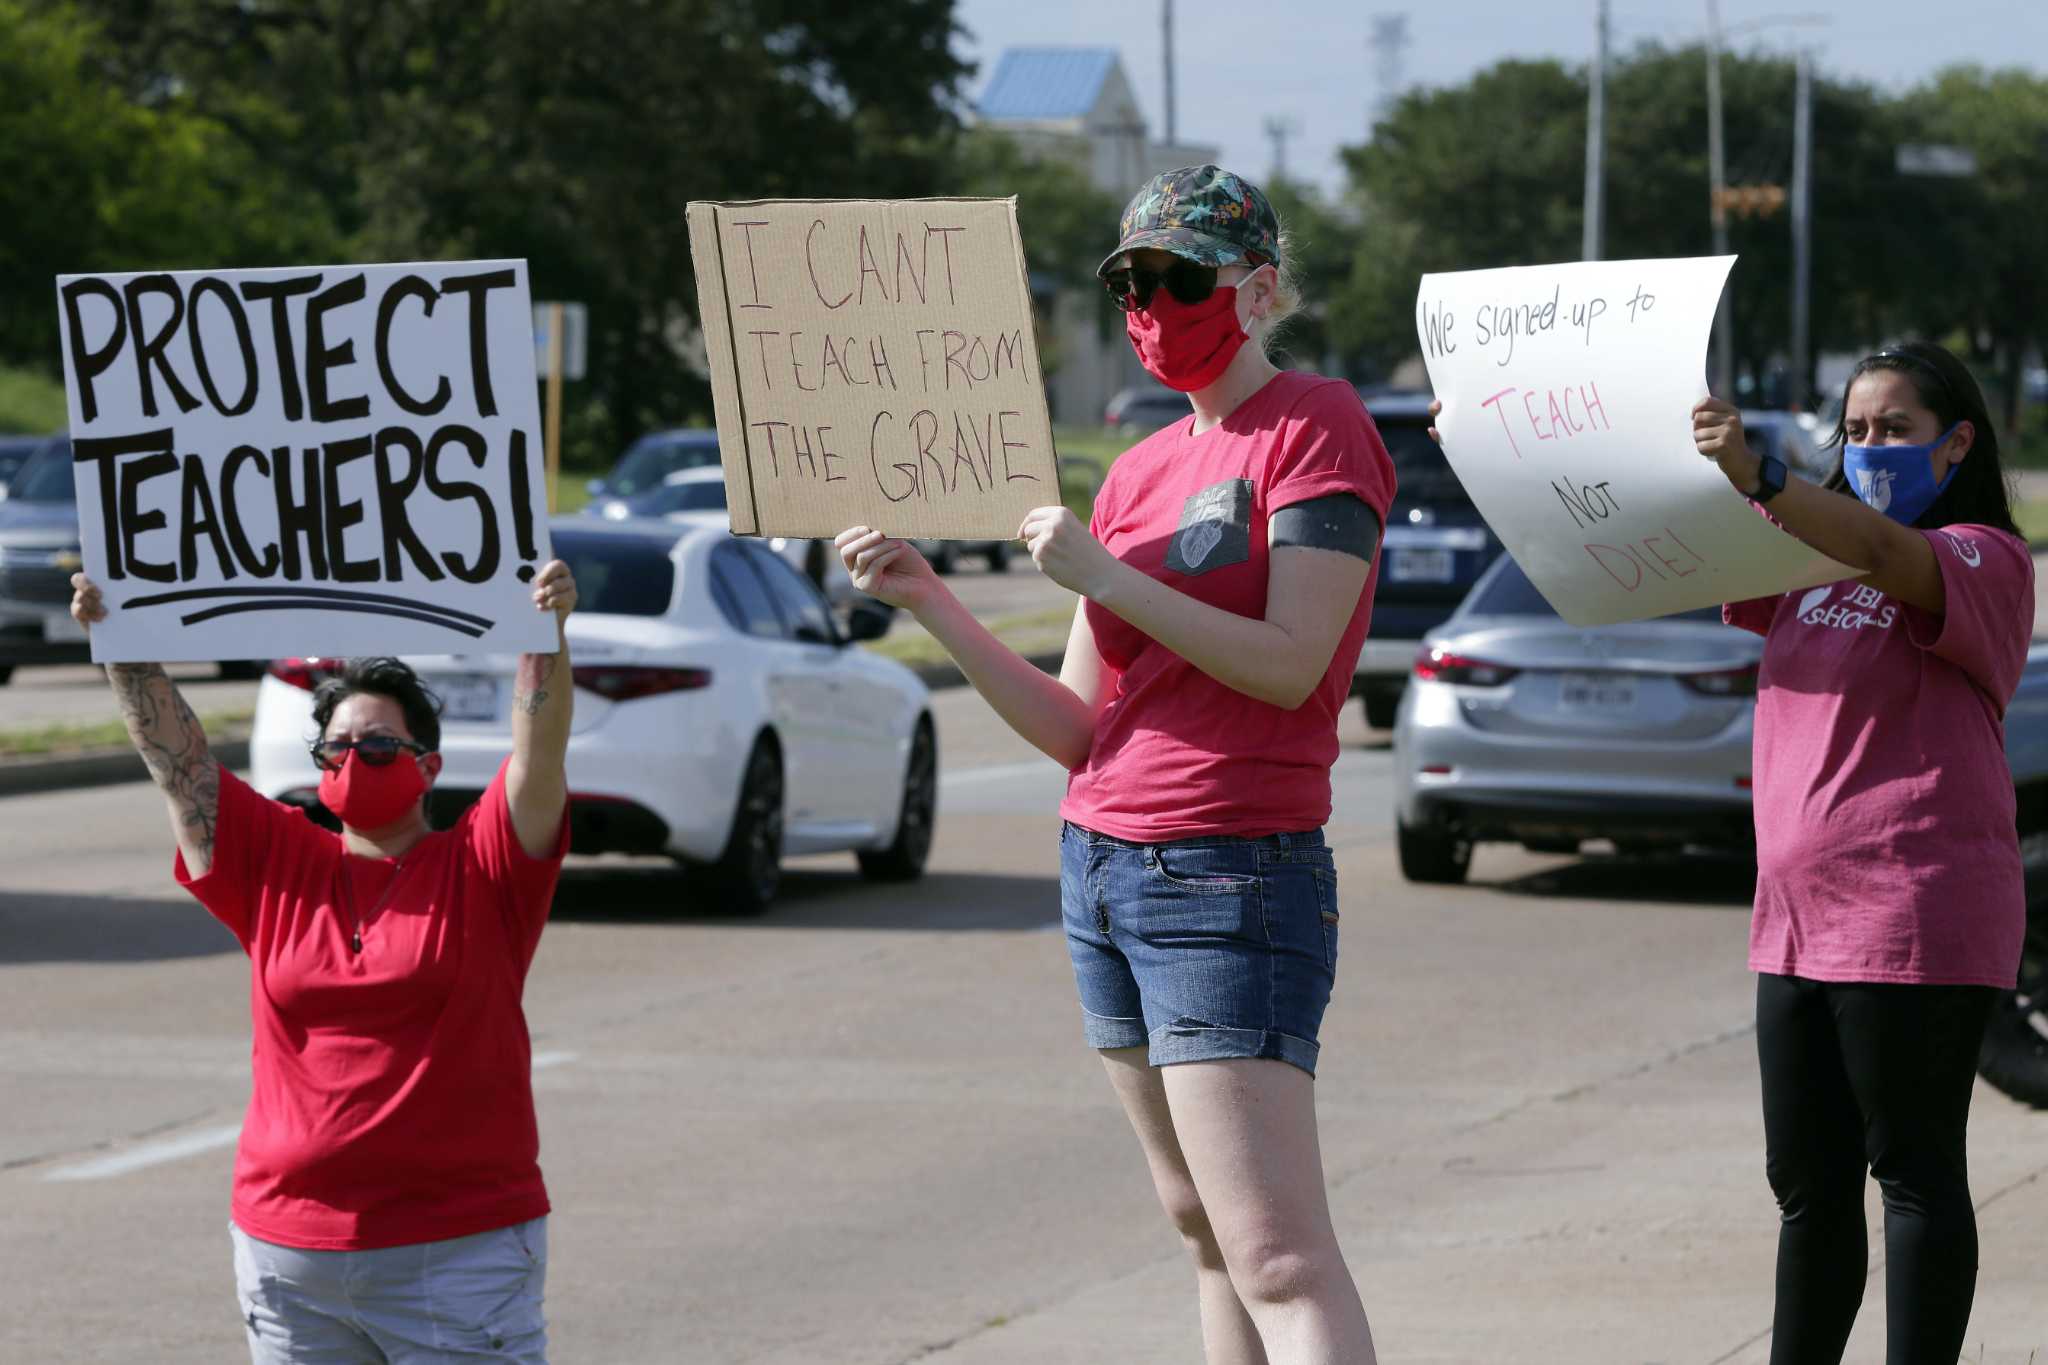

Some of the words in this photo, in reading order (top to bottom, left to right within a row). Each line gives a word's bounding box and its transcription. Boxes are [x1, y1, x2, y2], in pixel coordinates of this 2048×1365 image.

[731, 221, 773, 309] I
[62, 268, 516, 423] PROTECT
[748, 330, 898, 392] TEACH
[916, 328, 1029, 393] FROM
[1422, 300, 1457, 359] We
[1626, 283, 1656, 324] to
[751, 421, 847, 483] THE
[870, 409, 1041, 503] GRAVE
[1481, 380, 1611, 460] TEACH
[72, 424, 538, 584] TEACHERS!
[1551, 475, 1620, 529] NOT
[1583, 527, 1719, 594] DIE!
